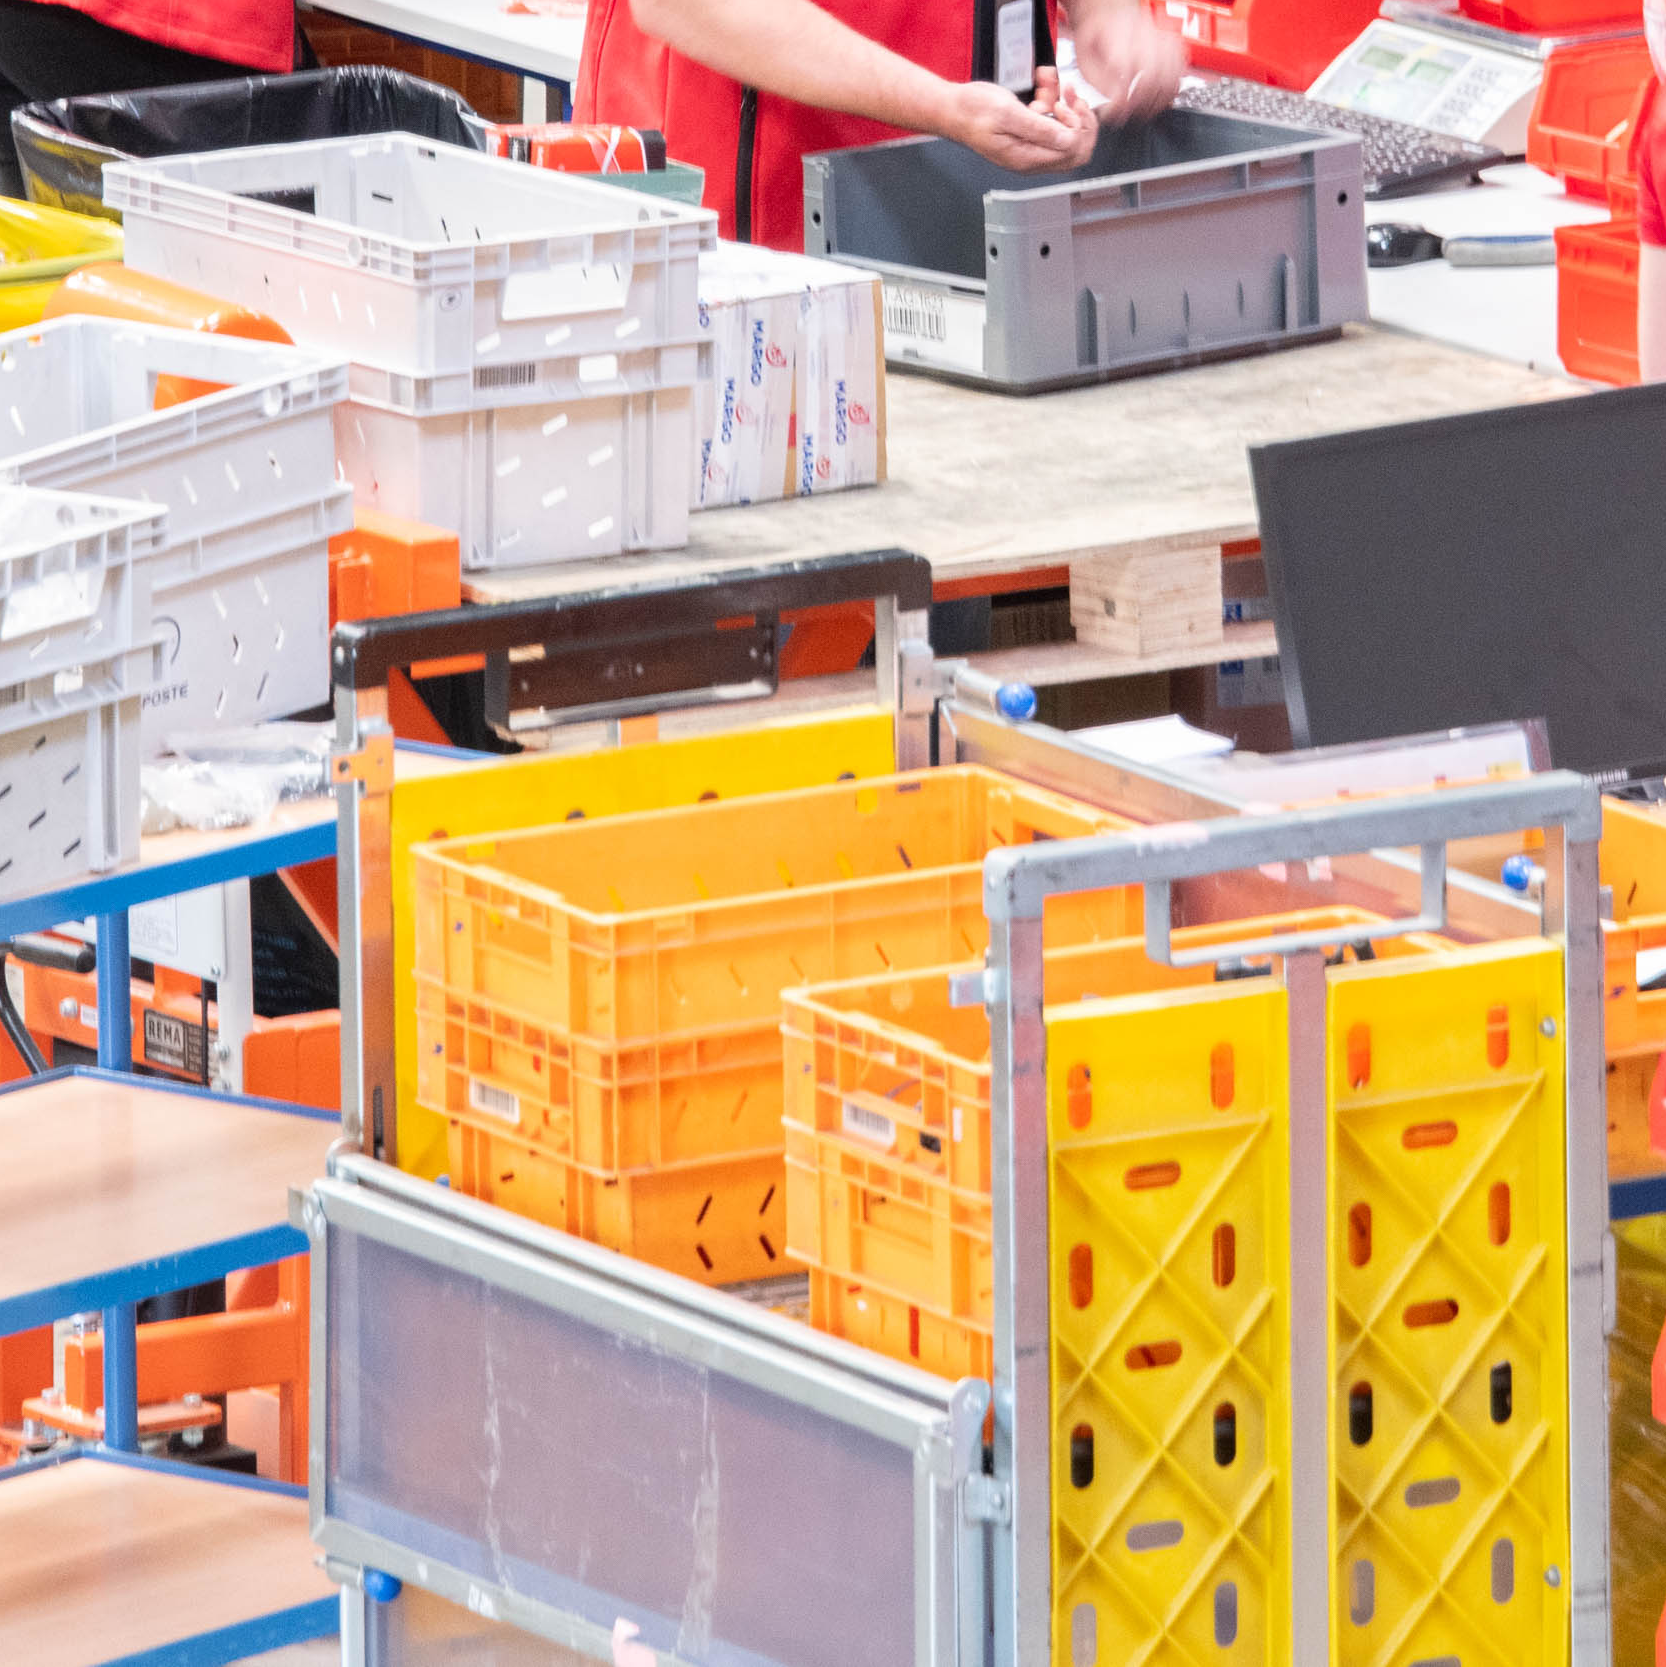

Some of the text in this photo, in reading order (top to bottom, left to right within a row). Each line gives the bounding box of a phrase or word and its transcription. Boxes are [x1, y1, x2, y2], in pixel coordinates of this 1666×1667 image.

[750, 318, 765, 386] MARGO
[721, 379, 736, 446] MARGO
[835, 380, 848, 446] MARGO
[142, 682, 190, 710] POSTE
[148, 1017, 181, 1048] REMA
